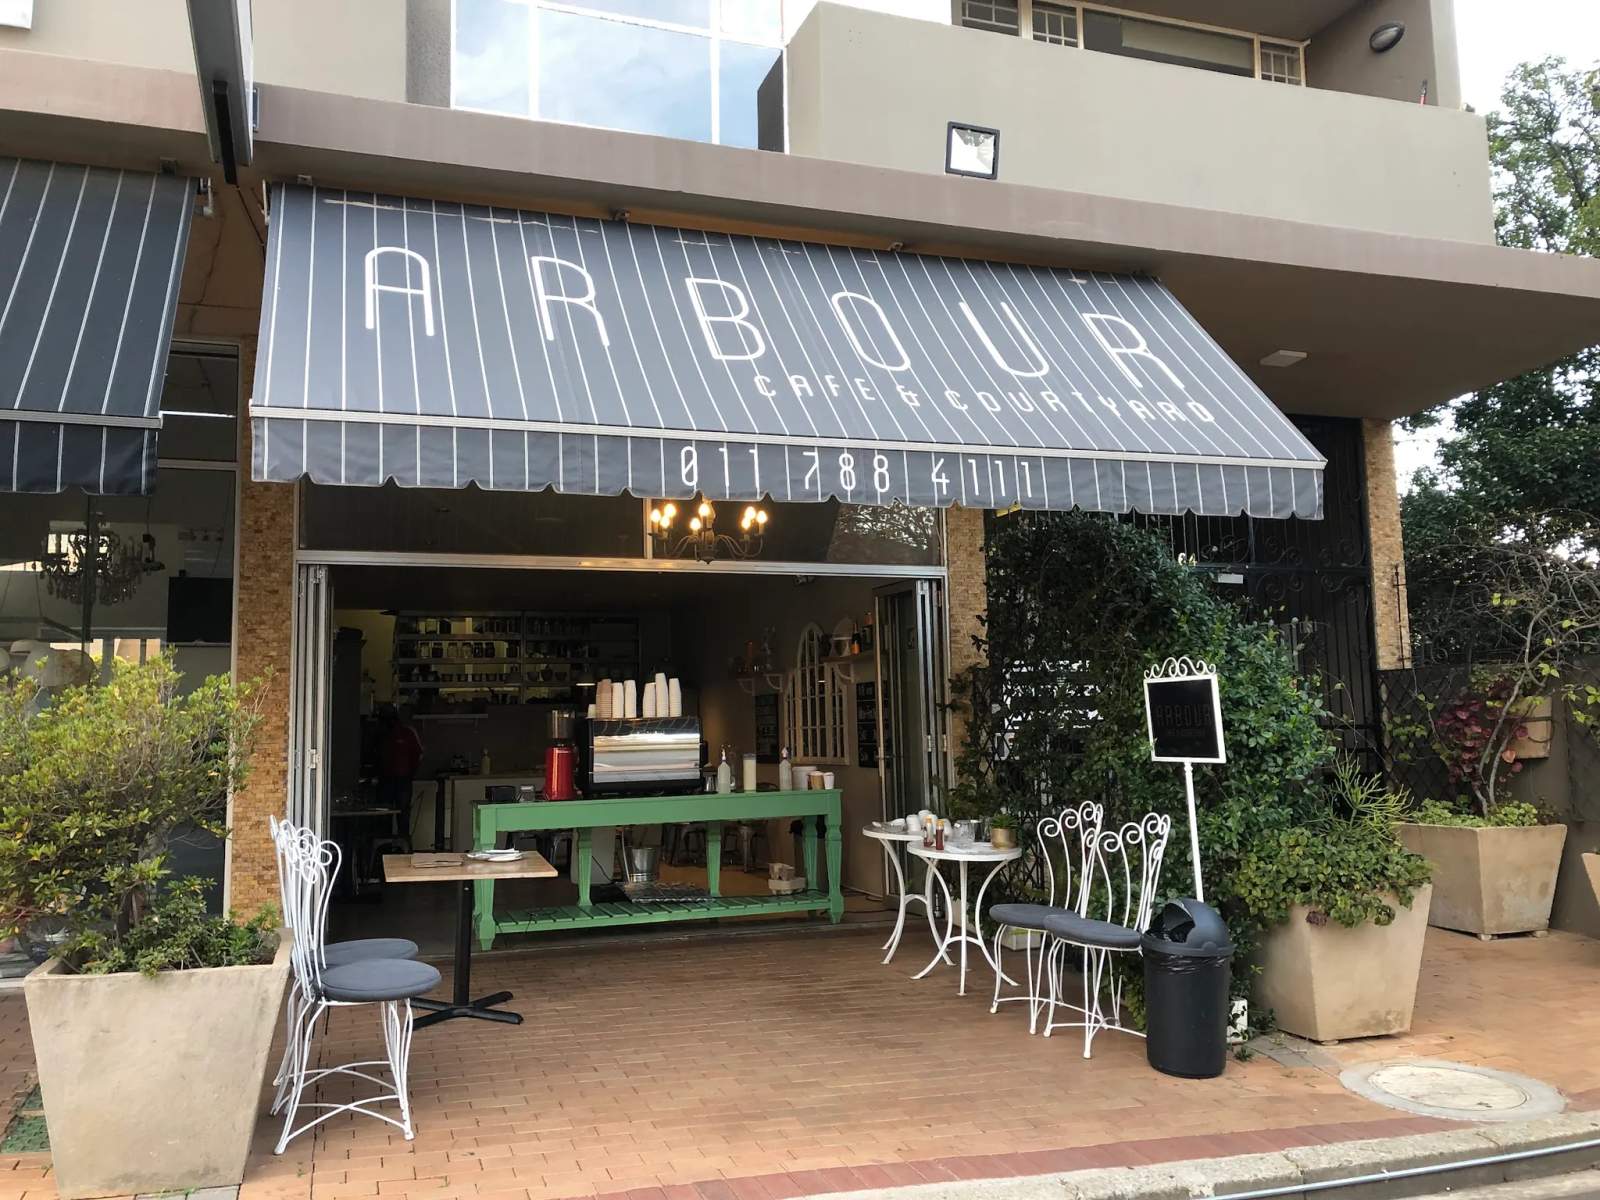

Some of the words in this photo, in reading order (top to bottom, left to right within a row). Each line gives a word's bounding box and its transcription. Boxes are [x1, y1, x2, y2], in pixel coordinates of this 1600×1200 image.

[365, 246, 1186, 390] ARBOUR
[754, 374, 875, 400] CAFE
[896, 384, 920, 407] &
[944, 390, 1215, 423] COURTYARD
[680, 446, 761, 489] 011
[803, 451, 890, 492] 788
[931, 458, 1032, 498] 4111
